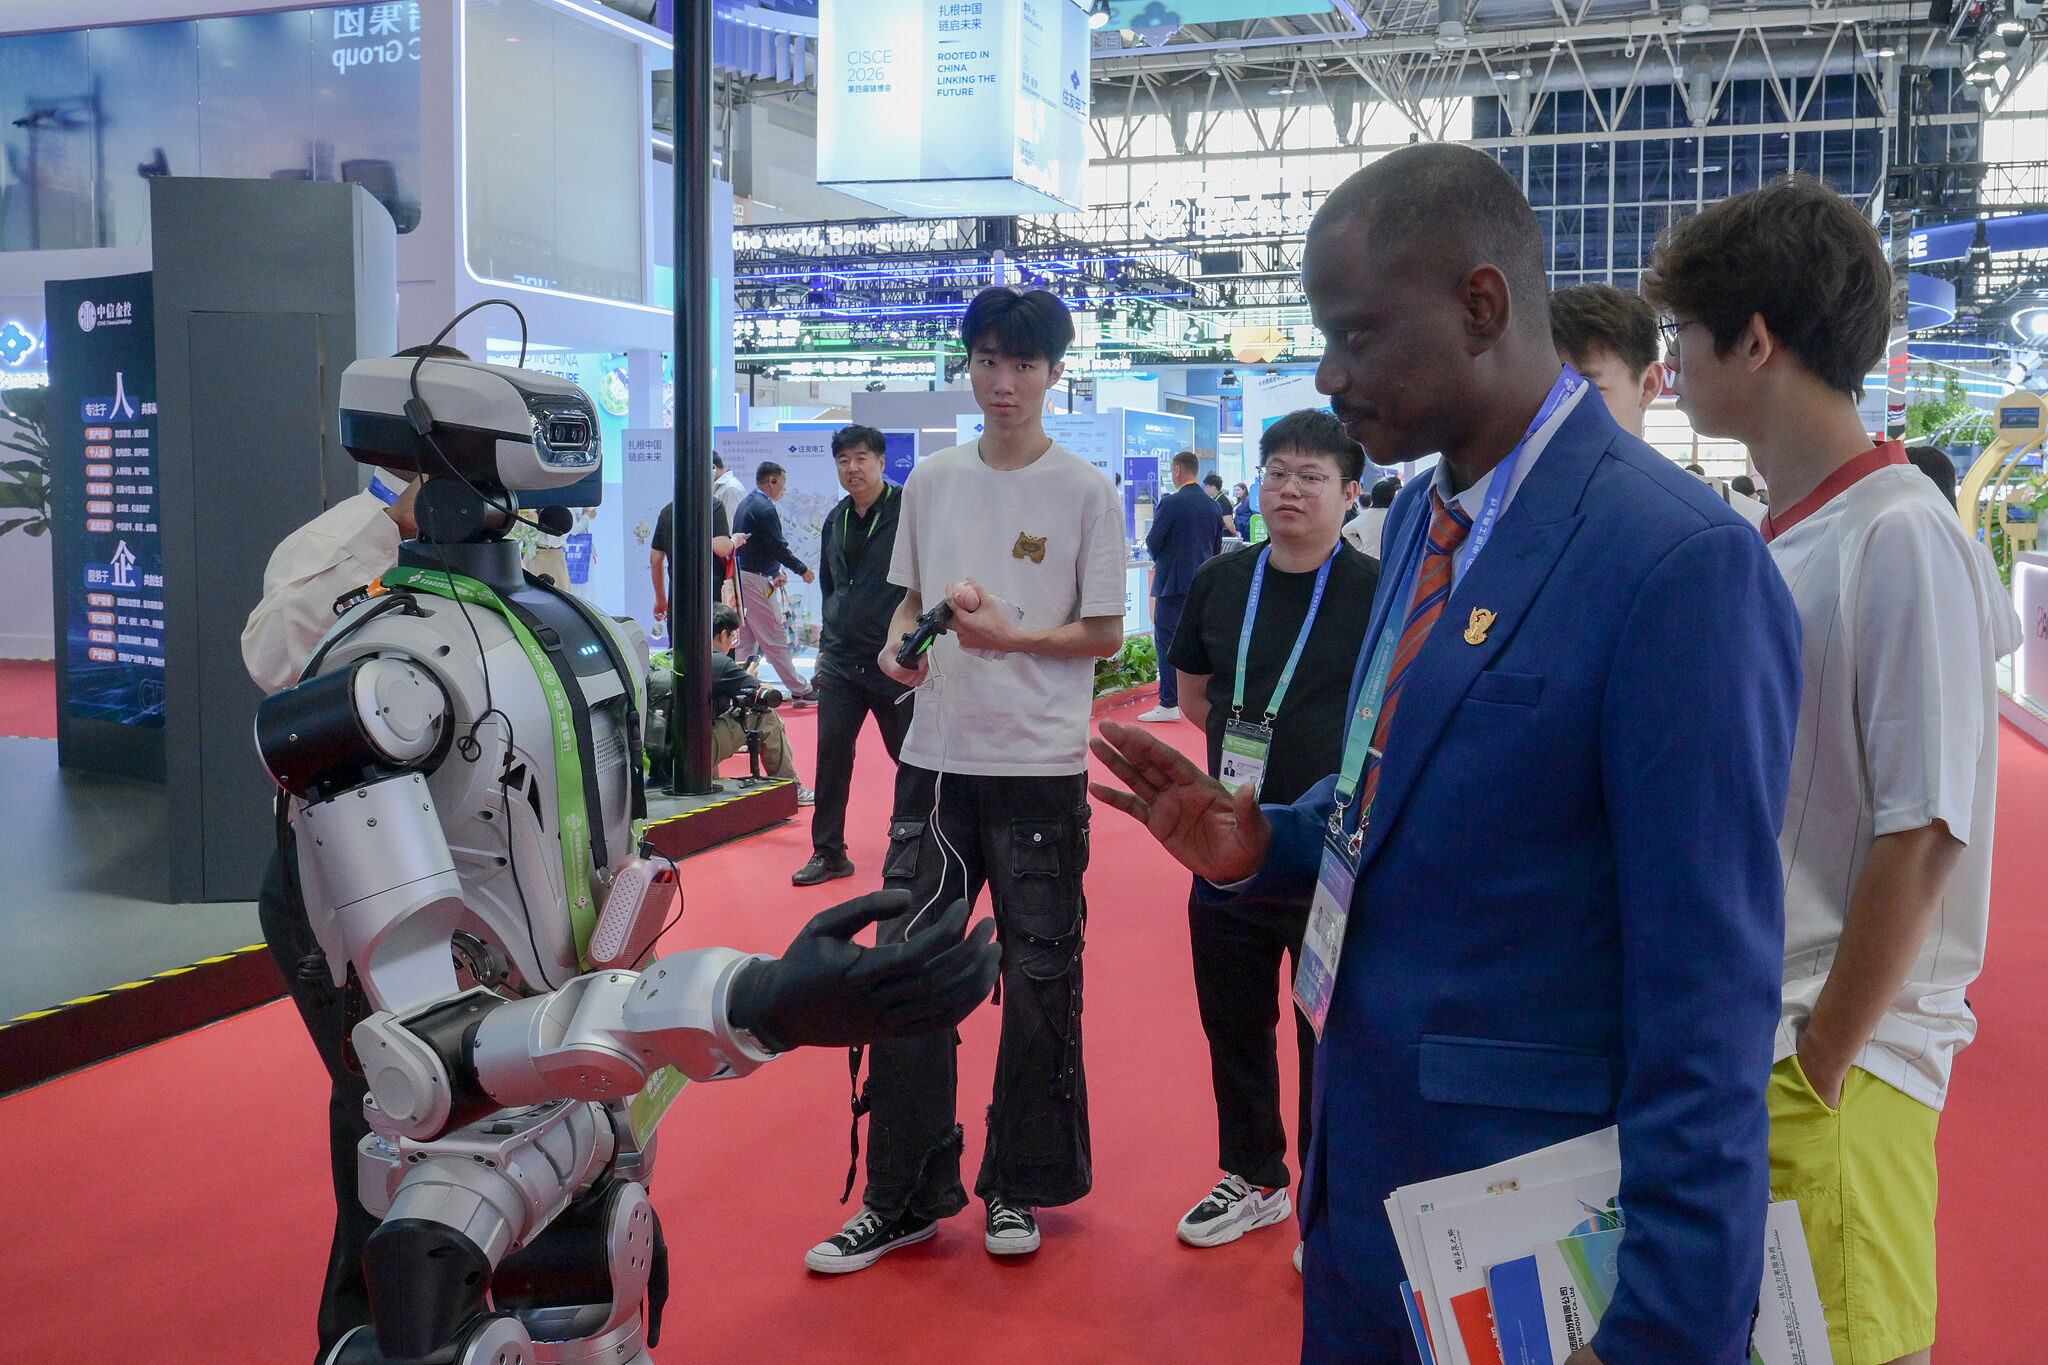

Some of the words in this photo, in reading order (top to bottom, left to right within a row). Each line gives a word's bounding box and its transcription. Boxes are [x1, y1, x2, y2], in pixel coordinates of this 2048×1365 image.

[939, 3, 982, 17] 扎根中国
[938, 18, 982, 32] 链启未来
[847, 50, 893, 65] CISCE
[937, 51, 977, 61] ROOTED
[979, 51, 990, 59] IN
[847, 67, 885, 82] 2026
[937, 64, 967, 73] CHINA
[937, 76, 976, 85] LINKING
[978, 75, 997, 83] THE
[937, 88, 974, 97] FUTURE
[732, 231, 762, 250] the
[766, 228, 825, 249] world,
[828, 222, 930, 245] Benefiting
[934, 219, 958, 240] all
[109, 372, 134, 419] 人
[629, 440, 662, 450] 扎根中国
[628, 453, 663, 462] 链启未来
[1472, 498, 1498, 553] 中国工商银行
[110, 540, 136, 587] 企
[529, 645, 547, 668] ICBC
[553, 690, 571, 751] 中国工商银行
[1560, 1287, 1578, 1353] 团股份有限公司
[1573, 1312, 1582, 1336] GROUP
